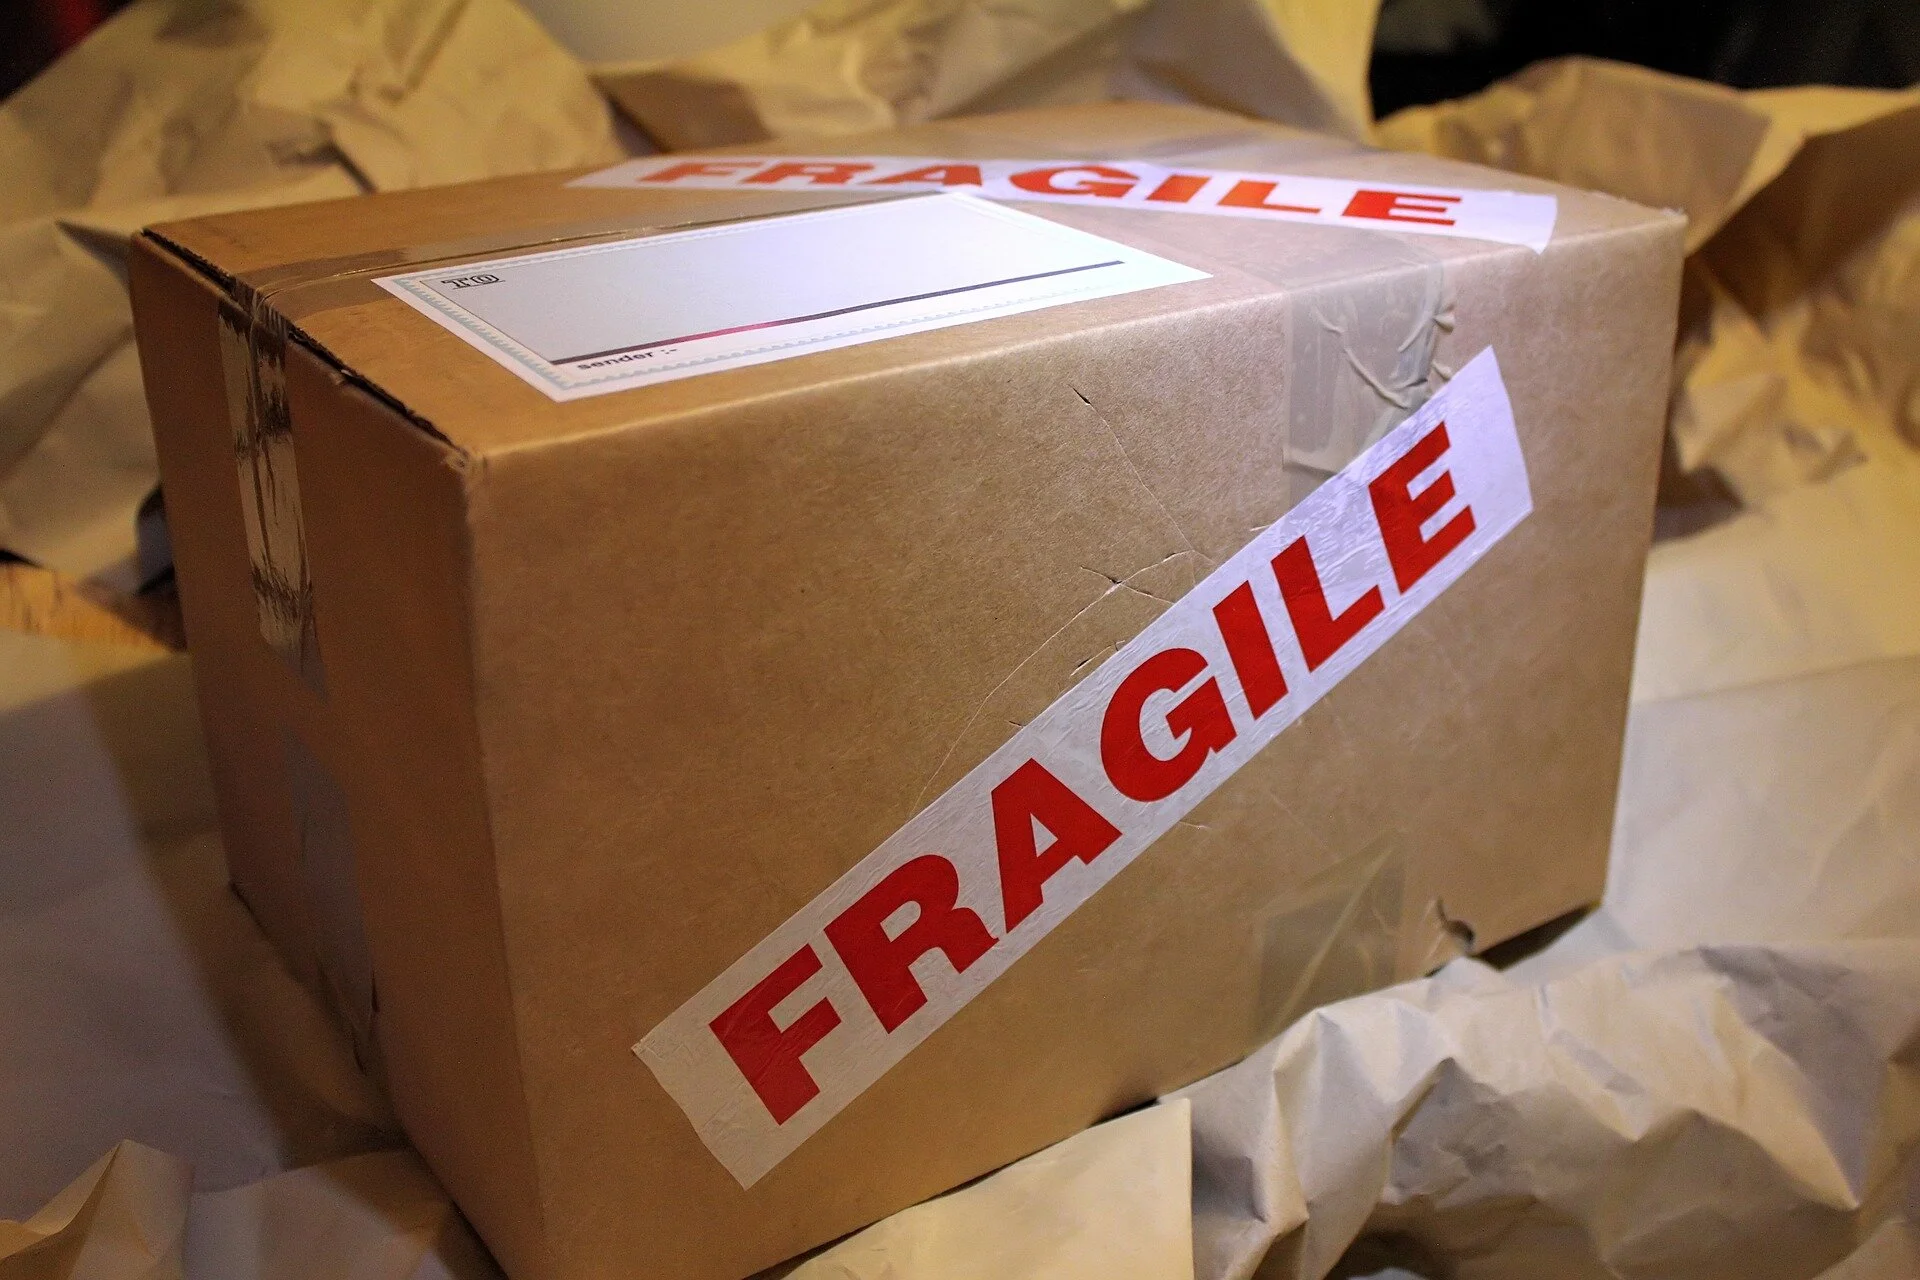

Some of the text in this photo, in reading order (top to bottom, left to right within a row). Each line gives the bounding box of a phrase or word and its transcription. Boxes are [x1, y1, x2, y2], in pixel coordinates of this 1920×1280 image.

[637, 162, 1462, 226] FRAGILE
[577, 352, 654, 370] sender
[709, 421, 1477, 1127] FRAGILE
